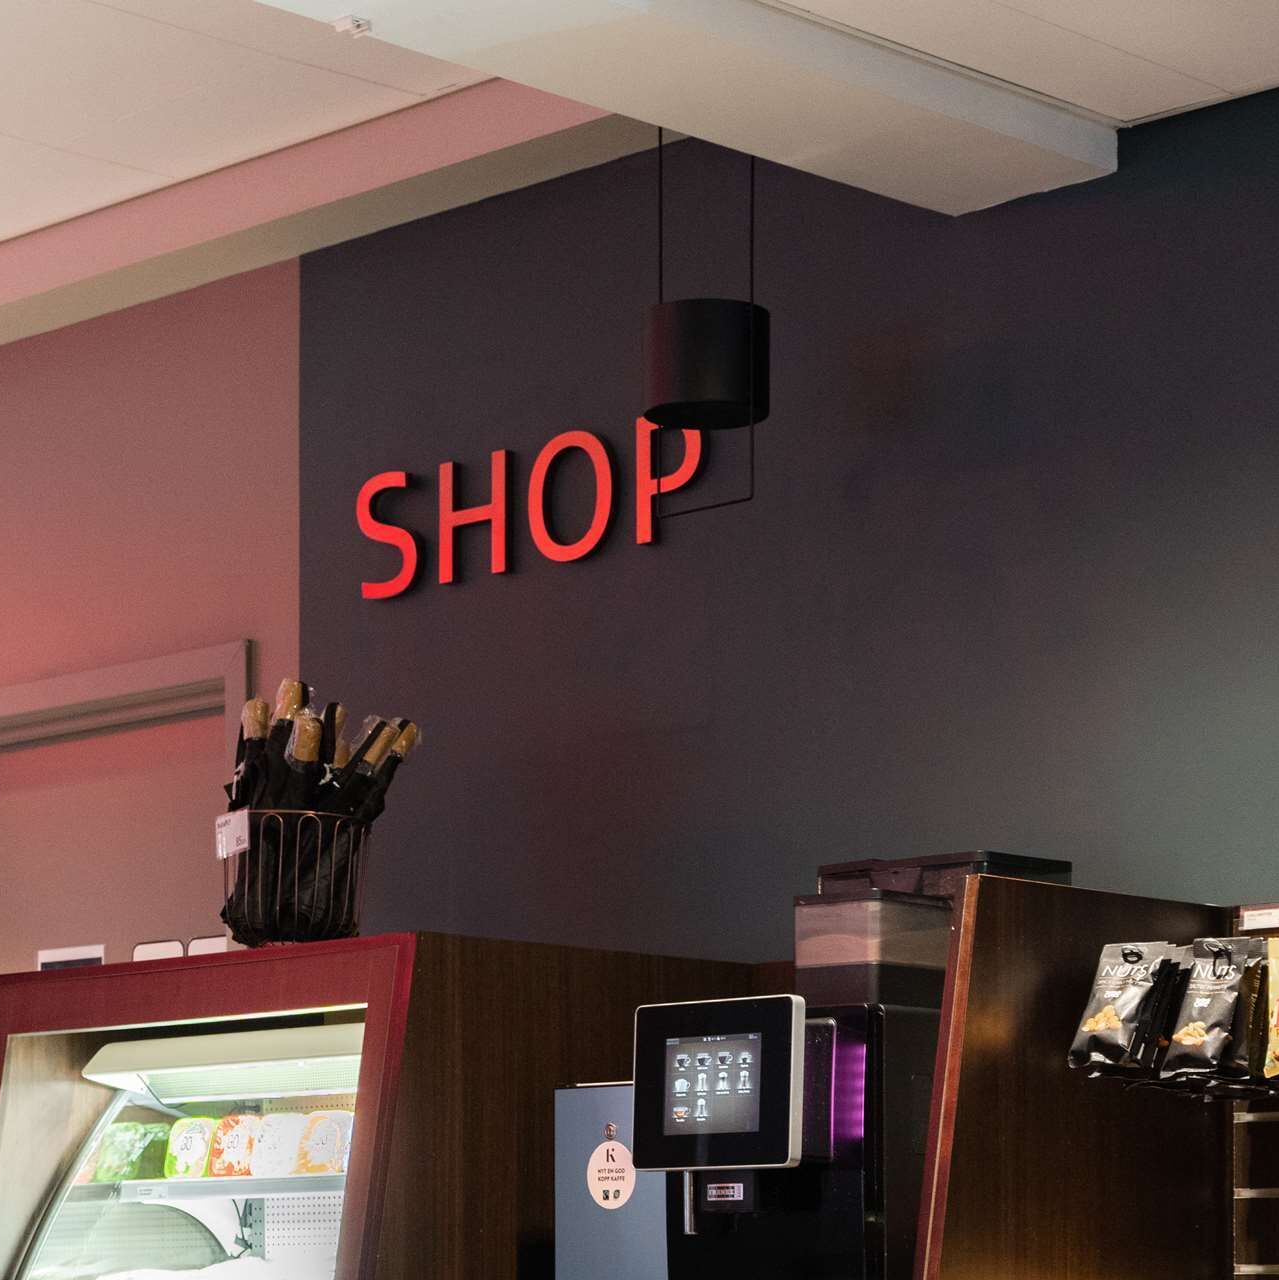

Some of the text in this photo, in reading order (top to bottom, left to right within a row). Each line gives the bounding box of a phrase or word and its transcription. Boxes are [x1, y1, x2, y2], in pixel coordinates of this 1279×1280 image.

[356, 417, 701, 599] SHOP
[1102, 965, 1148, 980] NUTS
[1193, 964, 1237, 980] NUTS
